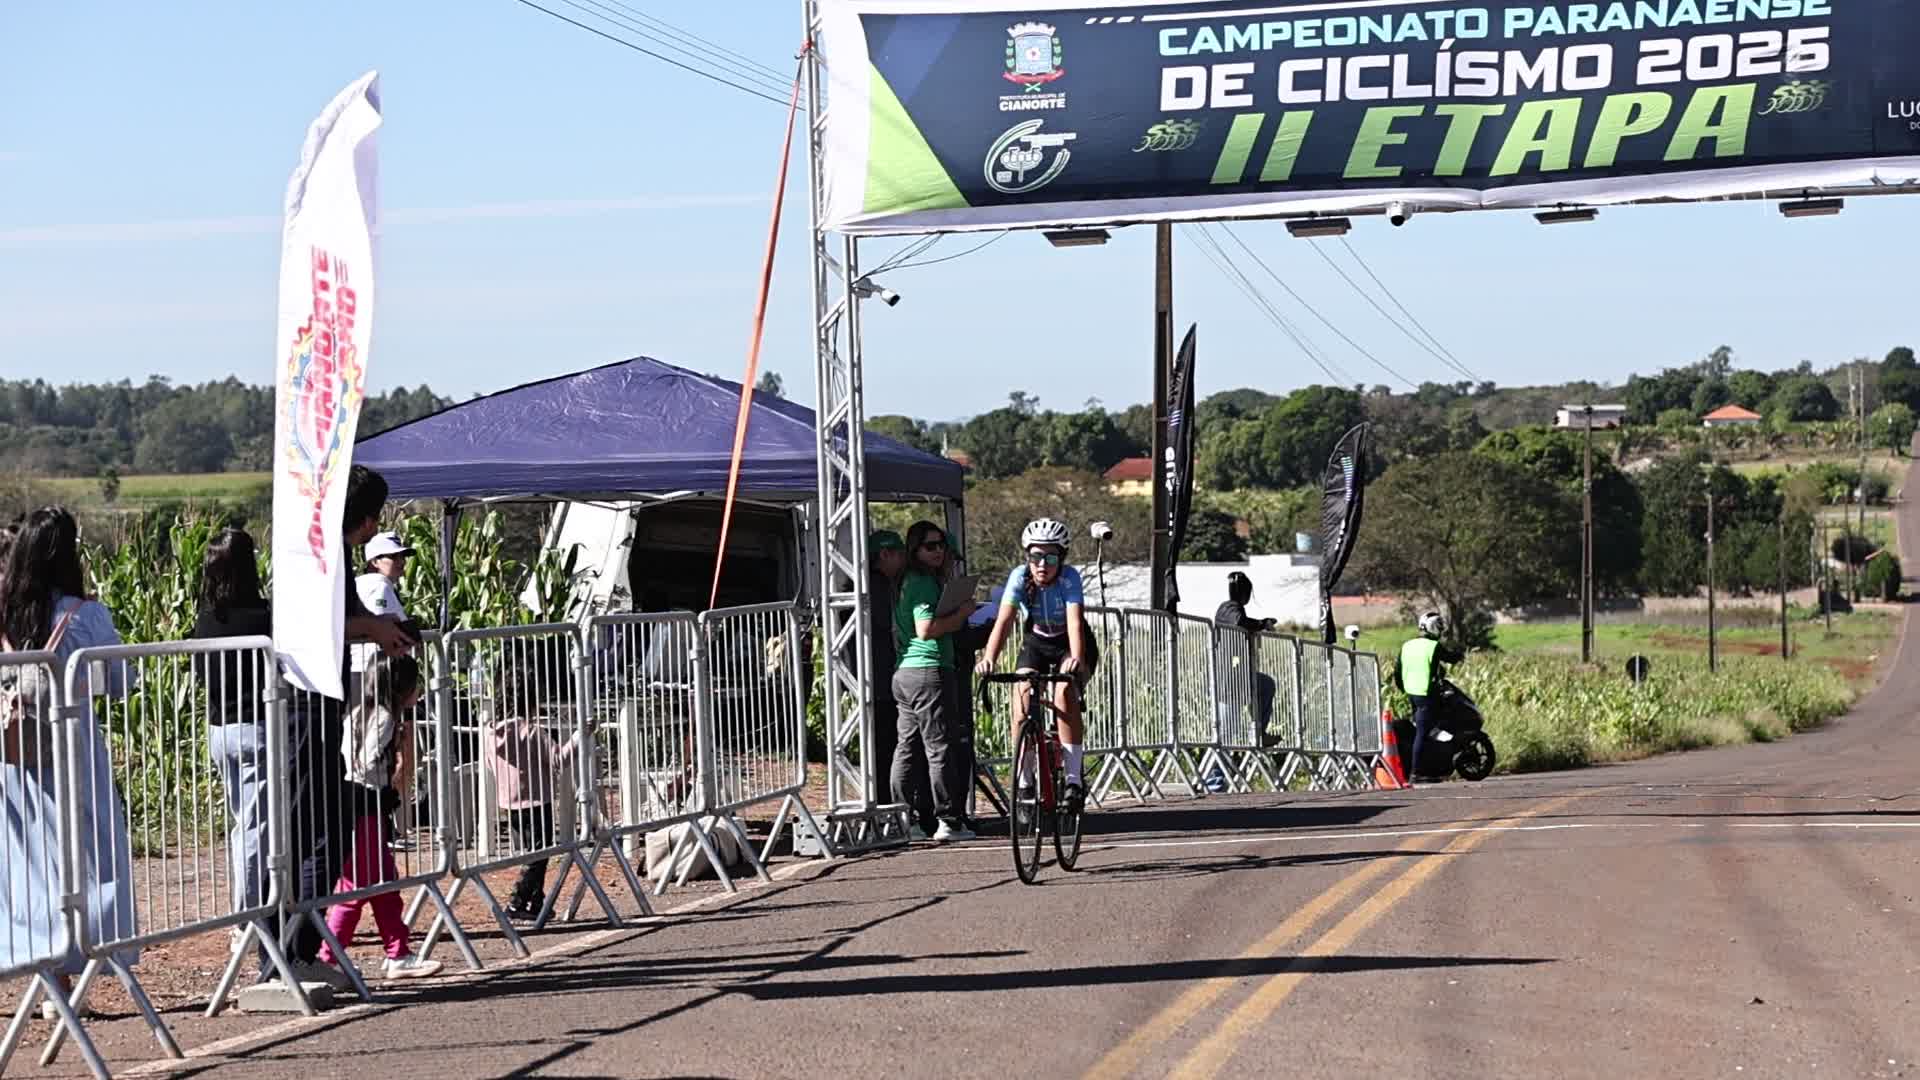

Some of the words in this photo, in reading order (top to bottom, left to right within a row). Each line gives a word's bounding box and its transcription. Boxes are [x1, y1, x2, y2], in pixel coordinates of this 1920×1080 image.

[1159, 8, 1488, 56] CAMPEONATO
[1504, 0, 1831, 38] PARANAENSE
[1000, 98, 1067, 111] CIANORTE
[1160, 62, 1255, 111] DE
[1278, 39, 1613, 104] CICLÍSMO
[1209, 110, 1315, 184] II
[1342, 82, 1757, 178] ETAPA
